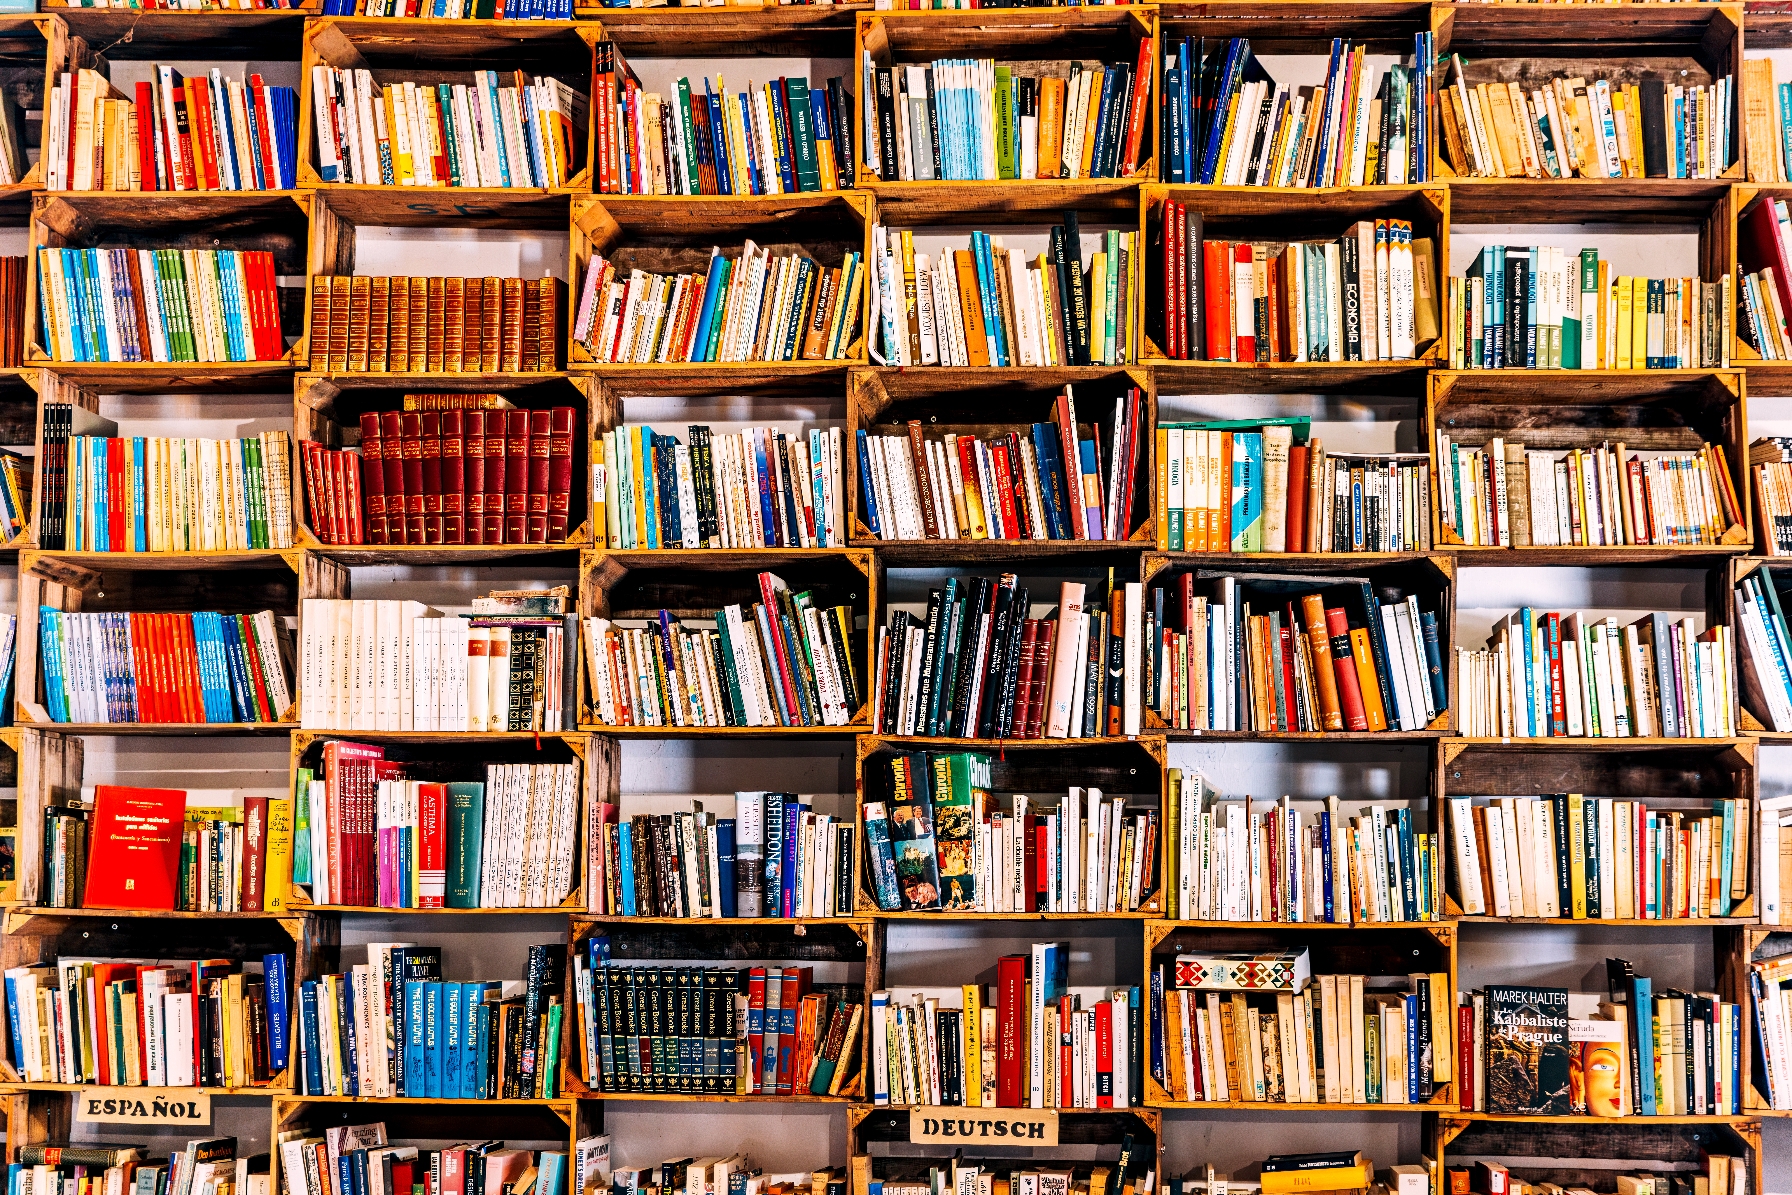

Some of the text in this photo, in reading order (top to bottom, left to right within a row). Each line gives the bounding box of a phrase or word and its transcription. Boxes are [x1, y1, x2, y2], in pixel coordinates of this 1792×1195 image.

[1346, 284, 1358, 342] ECONOMIA
[928, 607, 938, 633] Mundo
[922, 641, 934, 677] Mudaram
[1758, 600, 1787, 685] Pedro Cabrita Reis
[922, 679, 931, 694] que
[916, 696, 926, 732] Desastres
[892, 757, 906, 801] Chronik
[934, 758, 948, 802] Chronik
[428, 796, 436, 835] ASTHMA
[751, 798, 759, 844] SEBASTIAN
[767, 800, 782, 860] SHELDON
[329, 837, 338, 870] CLOCKS
[361, 973, 369, 1028] MACROECONOMICS
[1493, 990, 1567, 1006] MAREK HALTER
[1493, 1010, 1567, 1028] Kabbaliste
[1506, 1024, 1562, 1046] Prague
[88, 1095, 201, 1119] ESPAÑOL
[1573, 1101, 1586, 1112] 2€
[923, 1118, 1045, 1139] DEUTSCH
